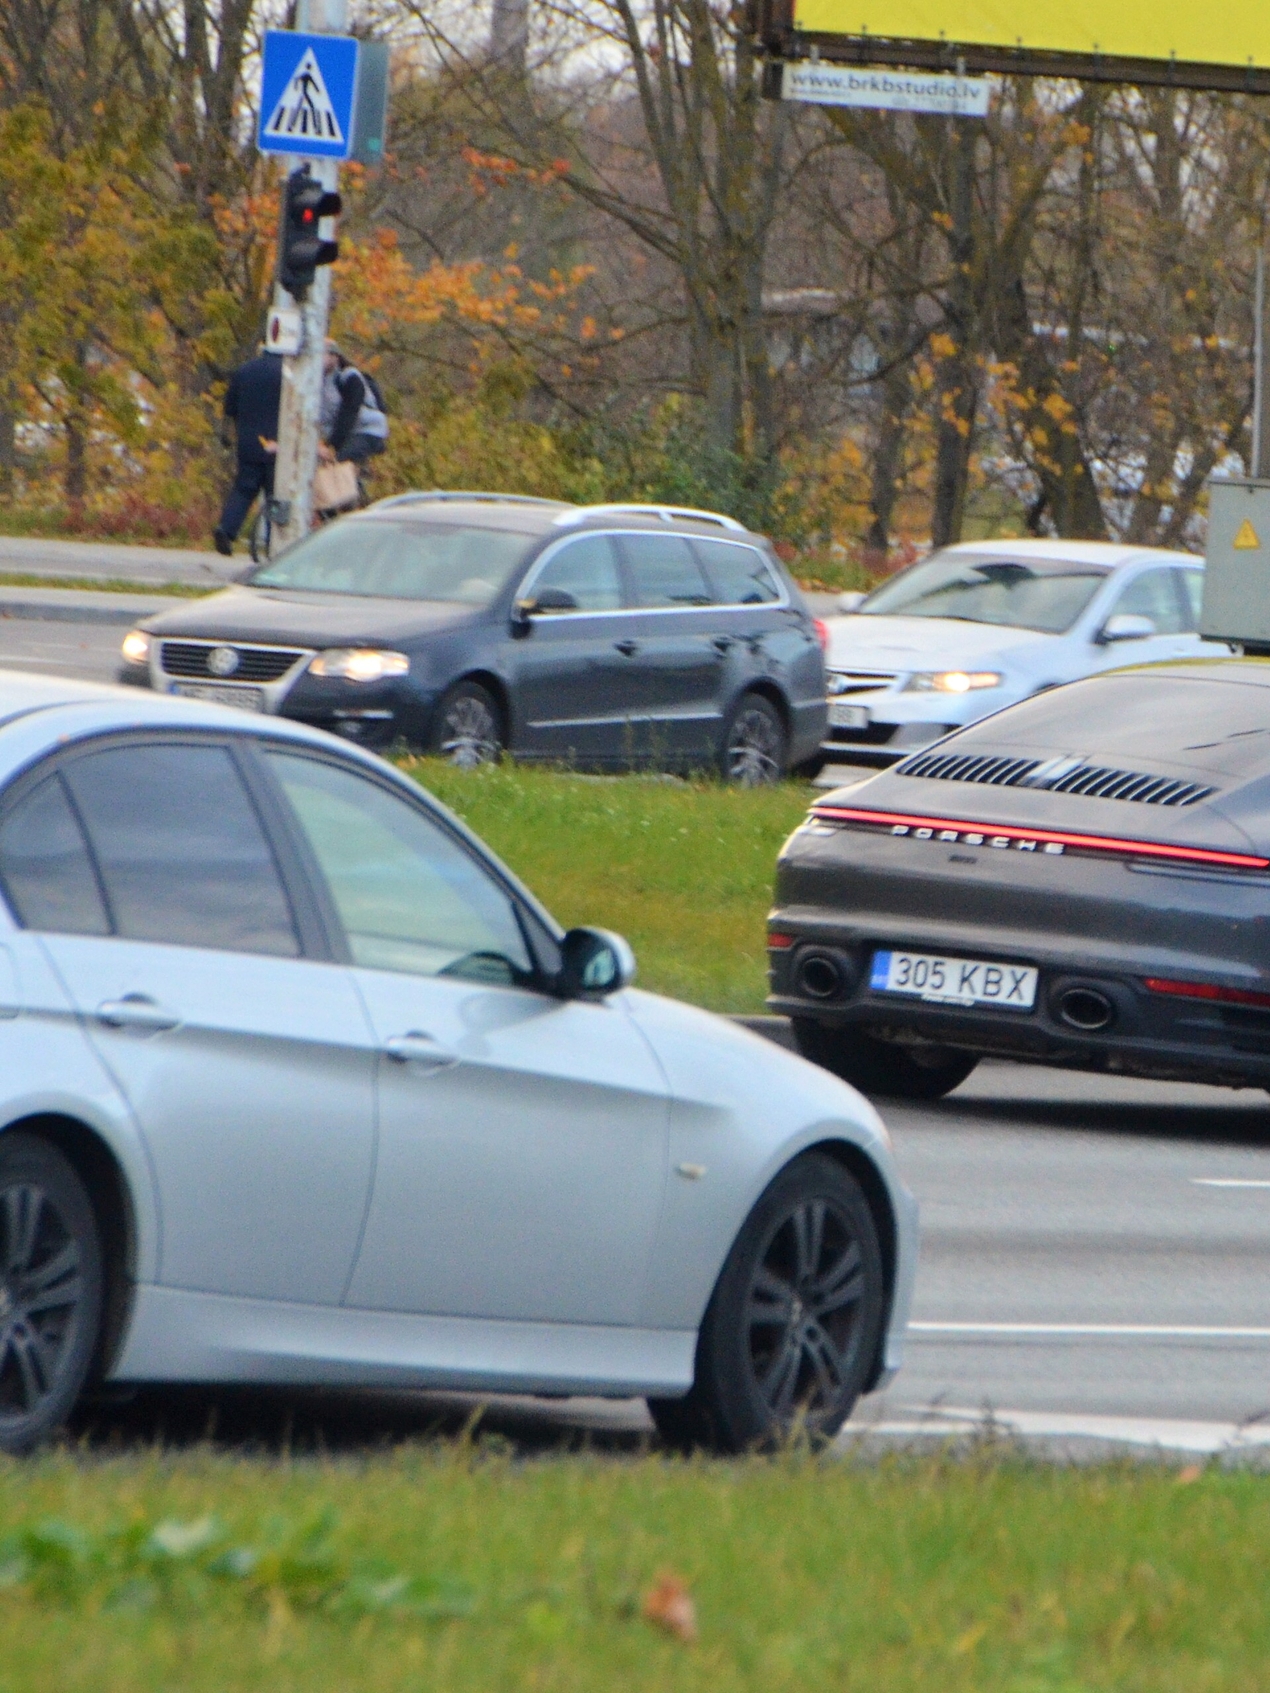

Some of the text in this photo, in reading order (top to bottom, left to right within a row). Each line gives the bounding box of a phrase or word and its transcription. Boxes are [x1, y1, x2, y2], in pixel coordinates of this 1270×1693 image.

[790, 73, 981, 98] www.brkbstudio.lv
[892, 824, 1064, 855] PORSCHE
[895, 957, 946, 990] 305
[957, 964, 1029, 1000] KBX
